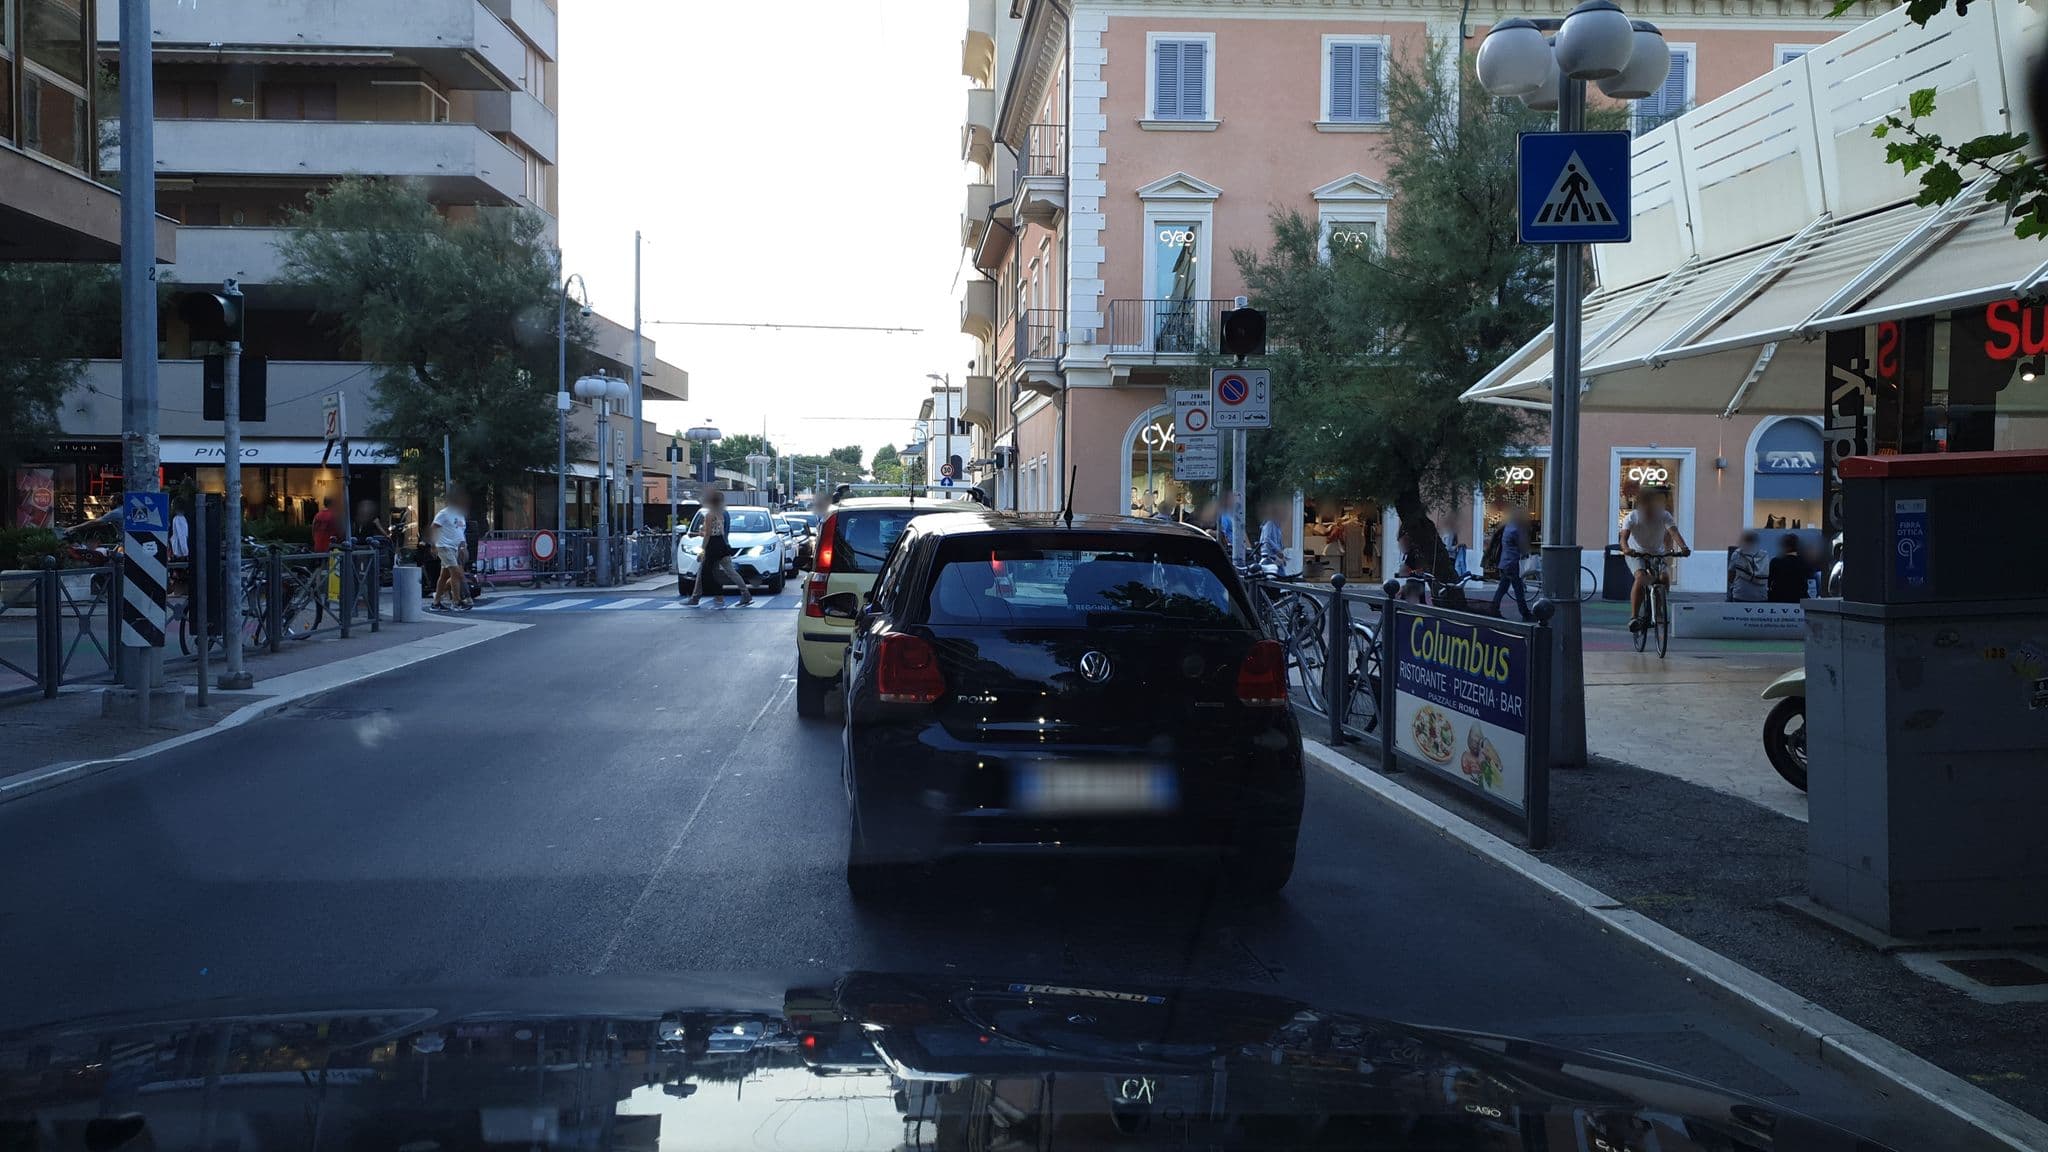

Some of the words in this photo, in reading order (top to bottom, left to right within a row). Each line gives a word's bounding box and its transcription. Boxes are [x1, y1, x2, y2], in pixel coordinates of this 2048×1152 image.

[1160, 230, 1195, 247] cyao
[1771, 457, 1811, 468] ZARA
[1494, 466, 1534, 484] cyao
[1629, 467, 1668, 485] cyao
[1411, 616, 1511, 681] Columbus
[1400, 660, 1447, 692] RISTORANTE
[1453, 678, 1496, 709] PIZZERIA
[1500, 692, 1522, 717] BAR
[1428, 692, 1457, 709] PIAZZALE
[1458, 703, 1480, 717] ROMA
